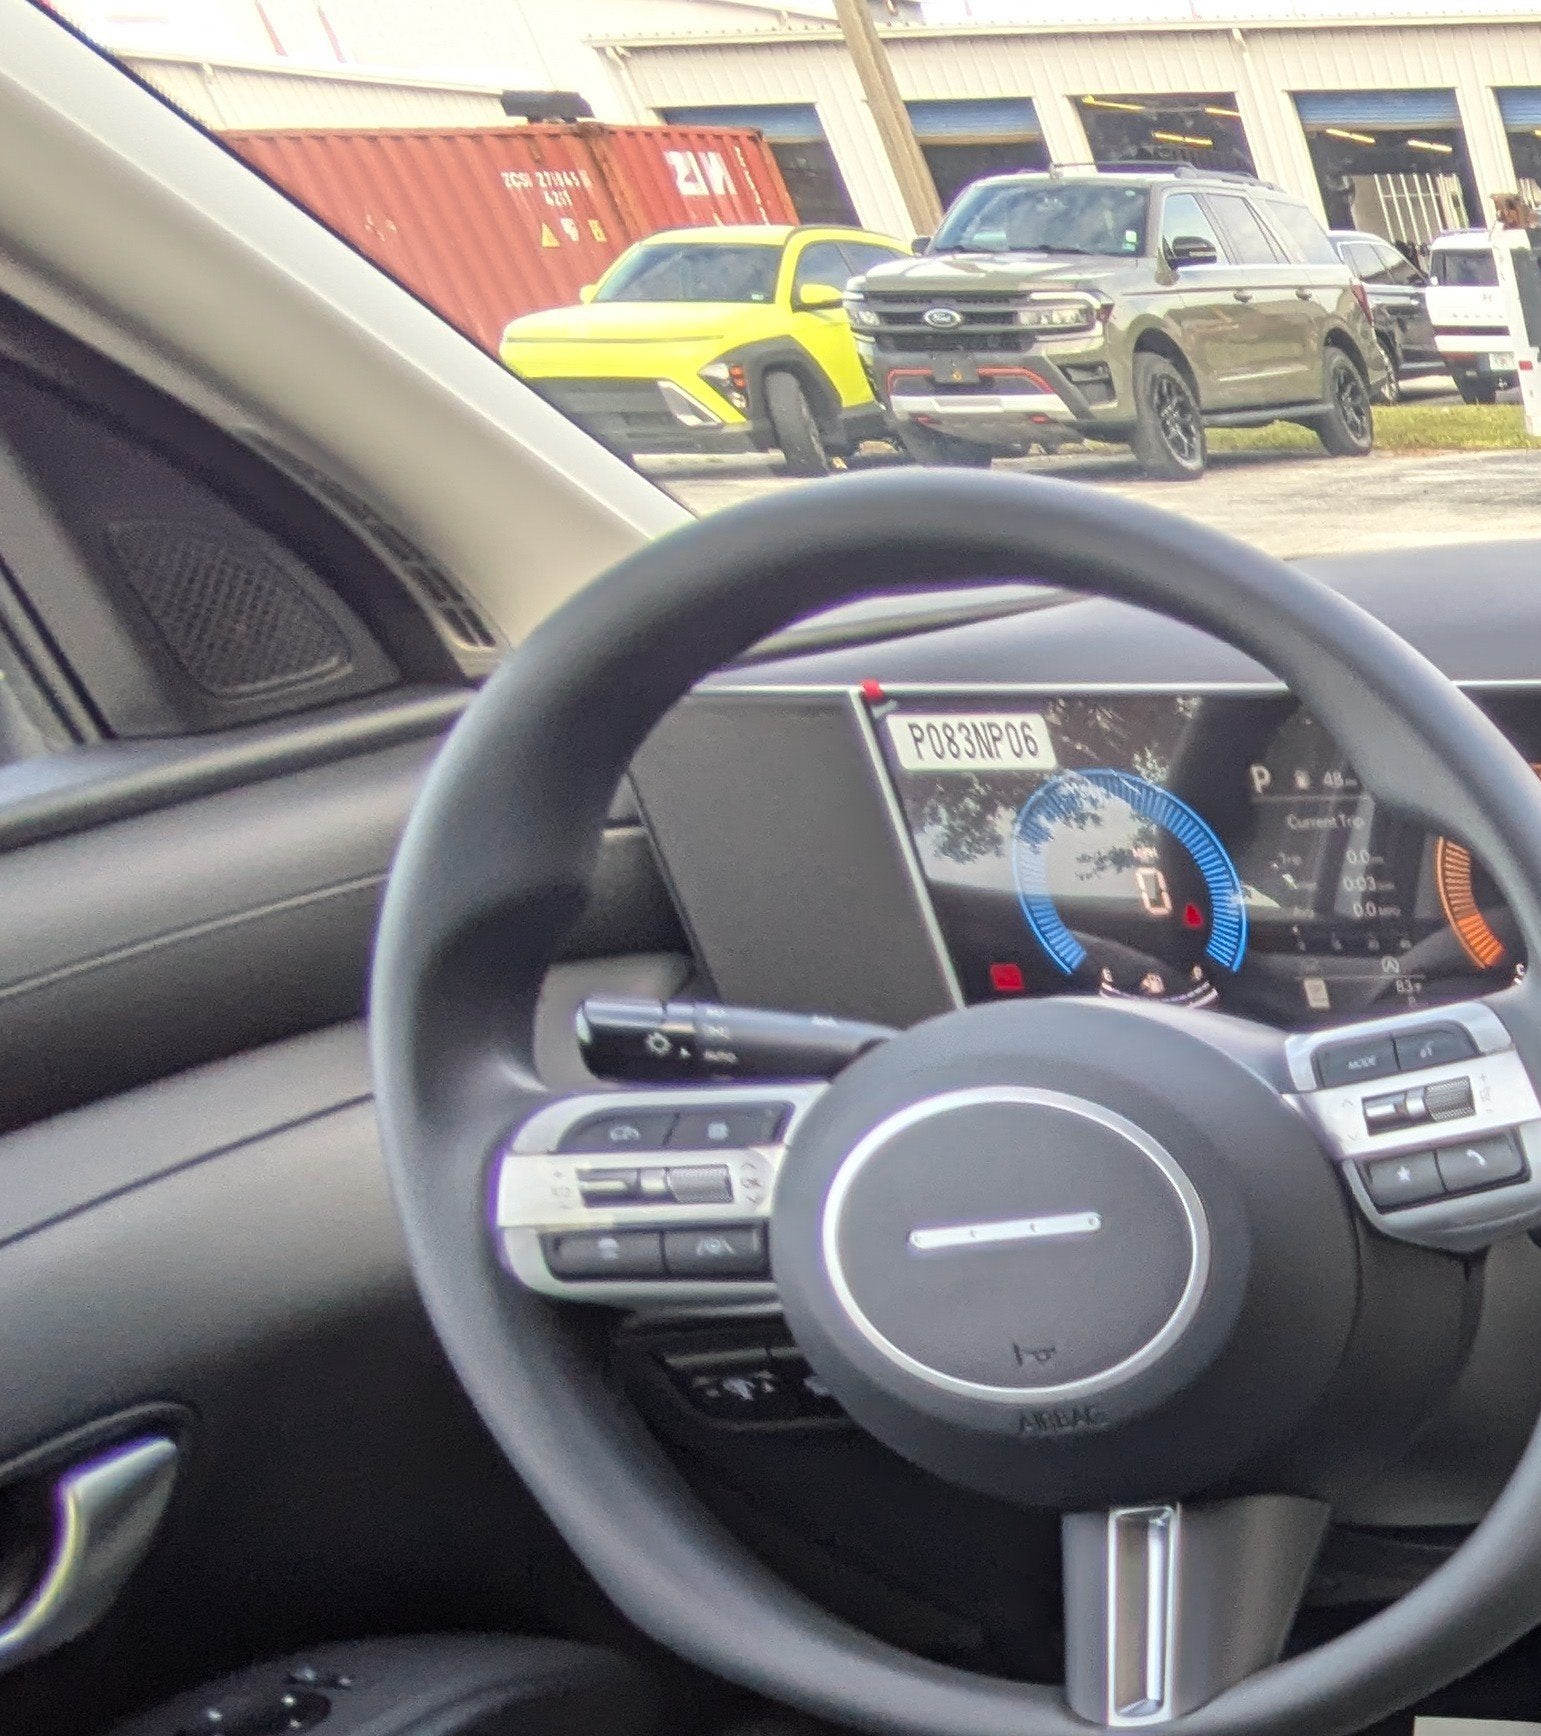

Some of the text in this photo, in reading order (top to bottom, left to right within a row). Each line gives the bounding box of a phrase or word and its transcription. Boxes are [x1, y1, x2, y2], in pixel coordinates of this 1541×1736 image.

[907, 720, 1040, 761] P083NP06
[1250, 764, 1272, 793] P
[1135, 866, 1173, 916] 0
